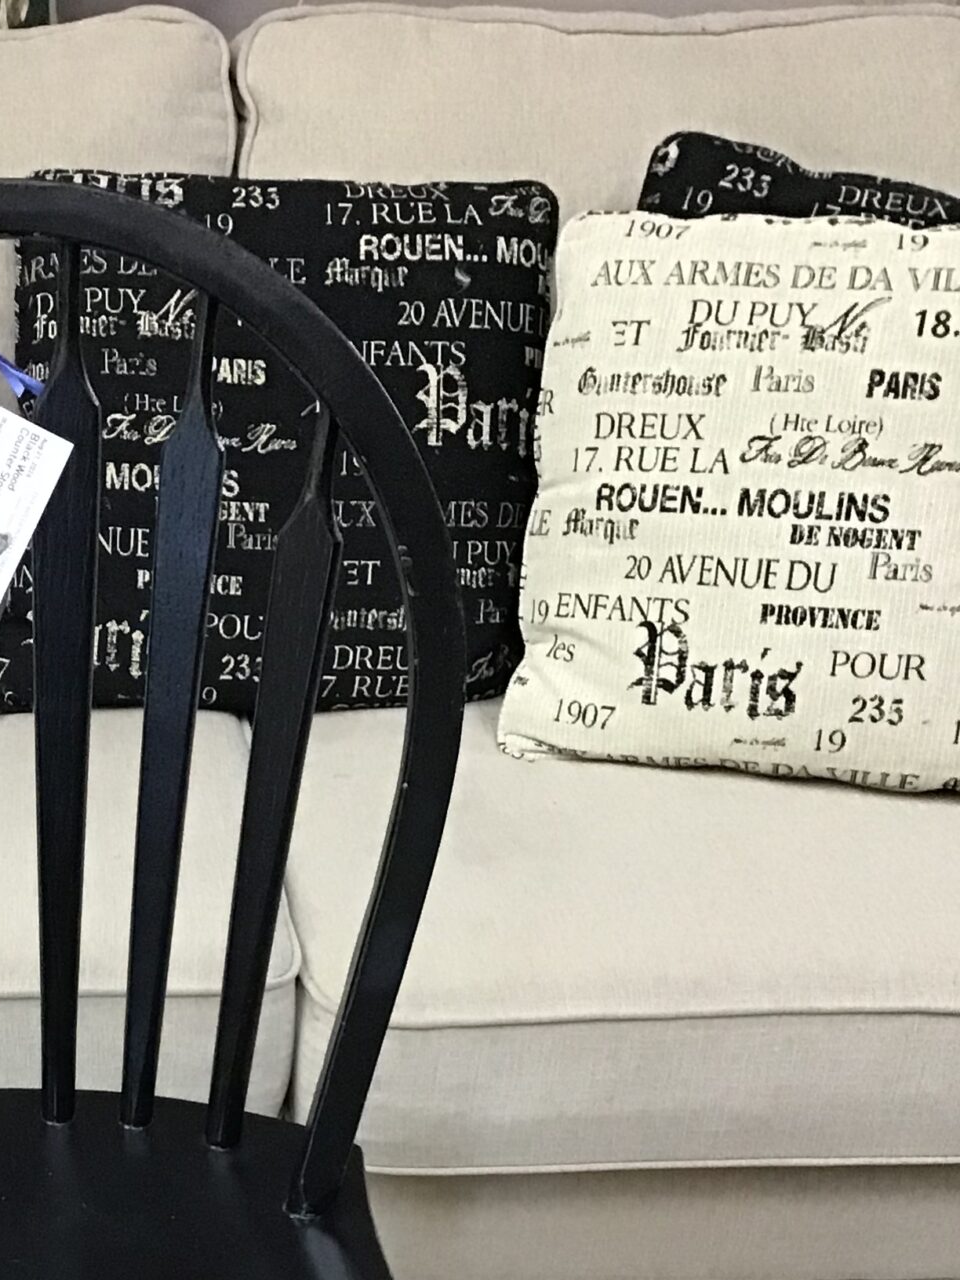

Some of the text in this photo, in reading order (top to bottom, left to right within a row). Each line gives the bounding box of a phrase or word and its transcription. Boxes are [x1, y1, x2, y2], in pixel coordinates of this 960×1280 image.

[325, 204, 360, 225] 17.
[371, 202, 436, 225] RUE
[446, 203, 483, 226] LA
[681, 186, 714, 213] 19
[838, 185, 949, 220] DREUX
[626, 220, 691, 240] 1907
[897, 233, 929, 251] 19
[358, 232, 489, 262] ROUEN...
[591, 260, 960, 292] AUX ARMES DE DA VIL
[84, 287, 147, 314] PUY
[687, 299, 740, 326] DU
[747, 301, 819, 328] PUY
[397, 299, 536, 334] 20 AVENUE
[612, 320, 651, 346] ET
[101, 348, 158, 376] Paris
[349, 340, 466, 367] NFANTS
[211, 356, 267, 385] ARIS
[750, 364, 815, 393] Paris
[866, 368, 942, 400] PARIS
[412, 363, 532, 456] Pari
[595, 412, 706, 440] DREUX
[3, 426, 31, 470] Counter
[6, 432, 41, 492] Black Wood
[572, 447, 603, 475] 17.
[613, 447, 682, 473] RUE
[690, 448, 731, 475] LA
[595, 482, 891, 523] ROUEN... MOULINS
[789, 523, 922, 551] DE NOGENT
[343, 560, 381, 585] ET
[624, 554, 838, 593] 20 AVENUE DU
[867, 551, 933, 583] Paris
[530, 592, 691, 625] 19 ENFANTS
[759, 604, 882, 631] PROVENCE
[332, 645, 408, 670] DREU
[546, 634, 576, 662] les
[627, 620, 804, 720] Paris
[830, 650, 927, 682] POUR
[321, 675, 344, 698] 7.
[553, 697, 617, 731] 1907
[848, 694, 905, 726] 235
[814, 728, 847, 753] 19
